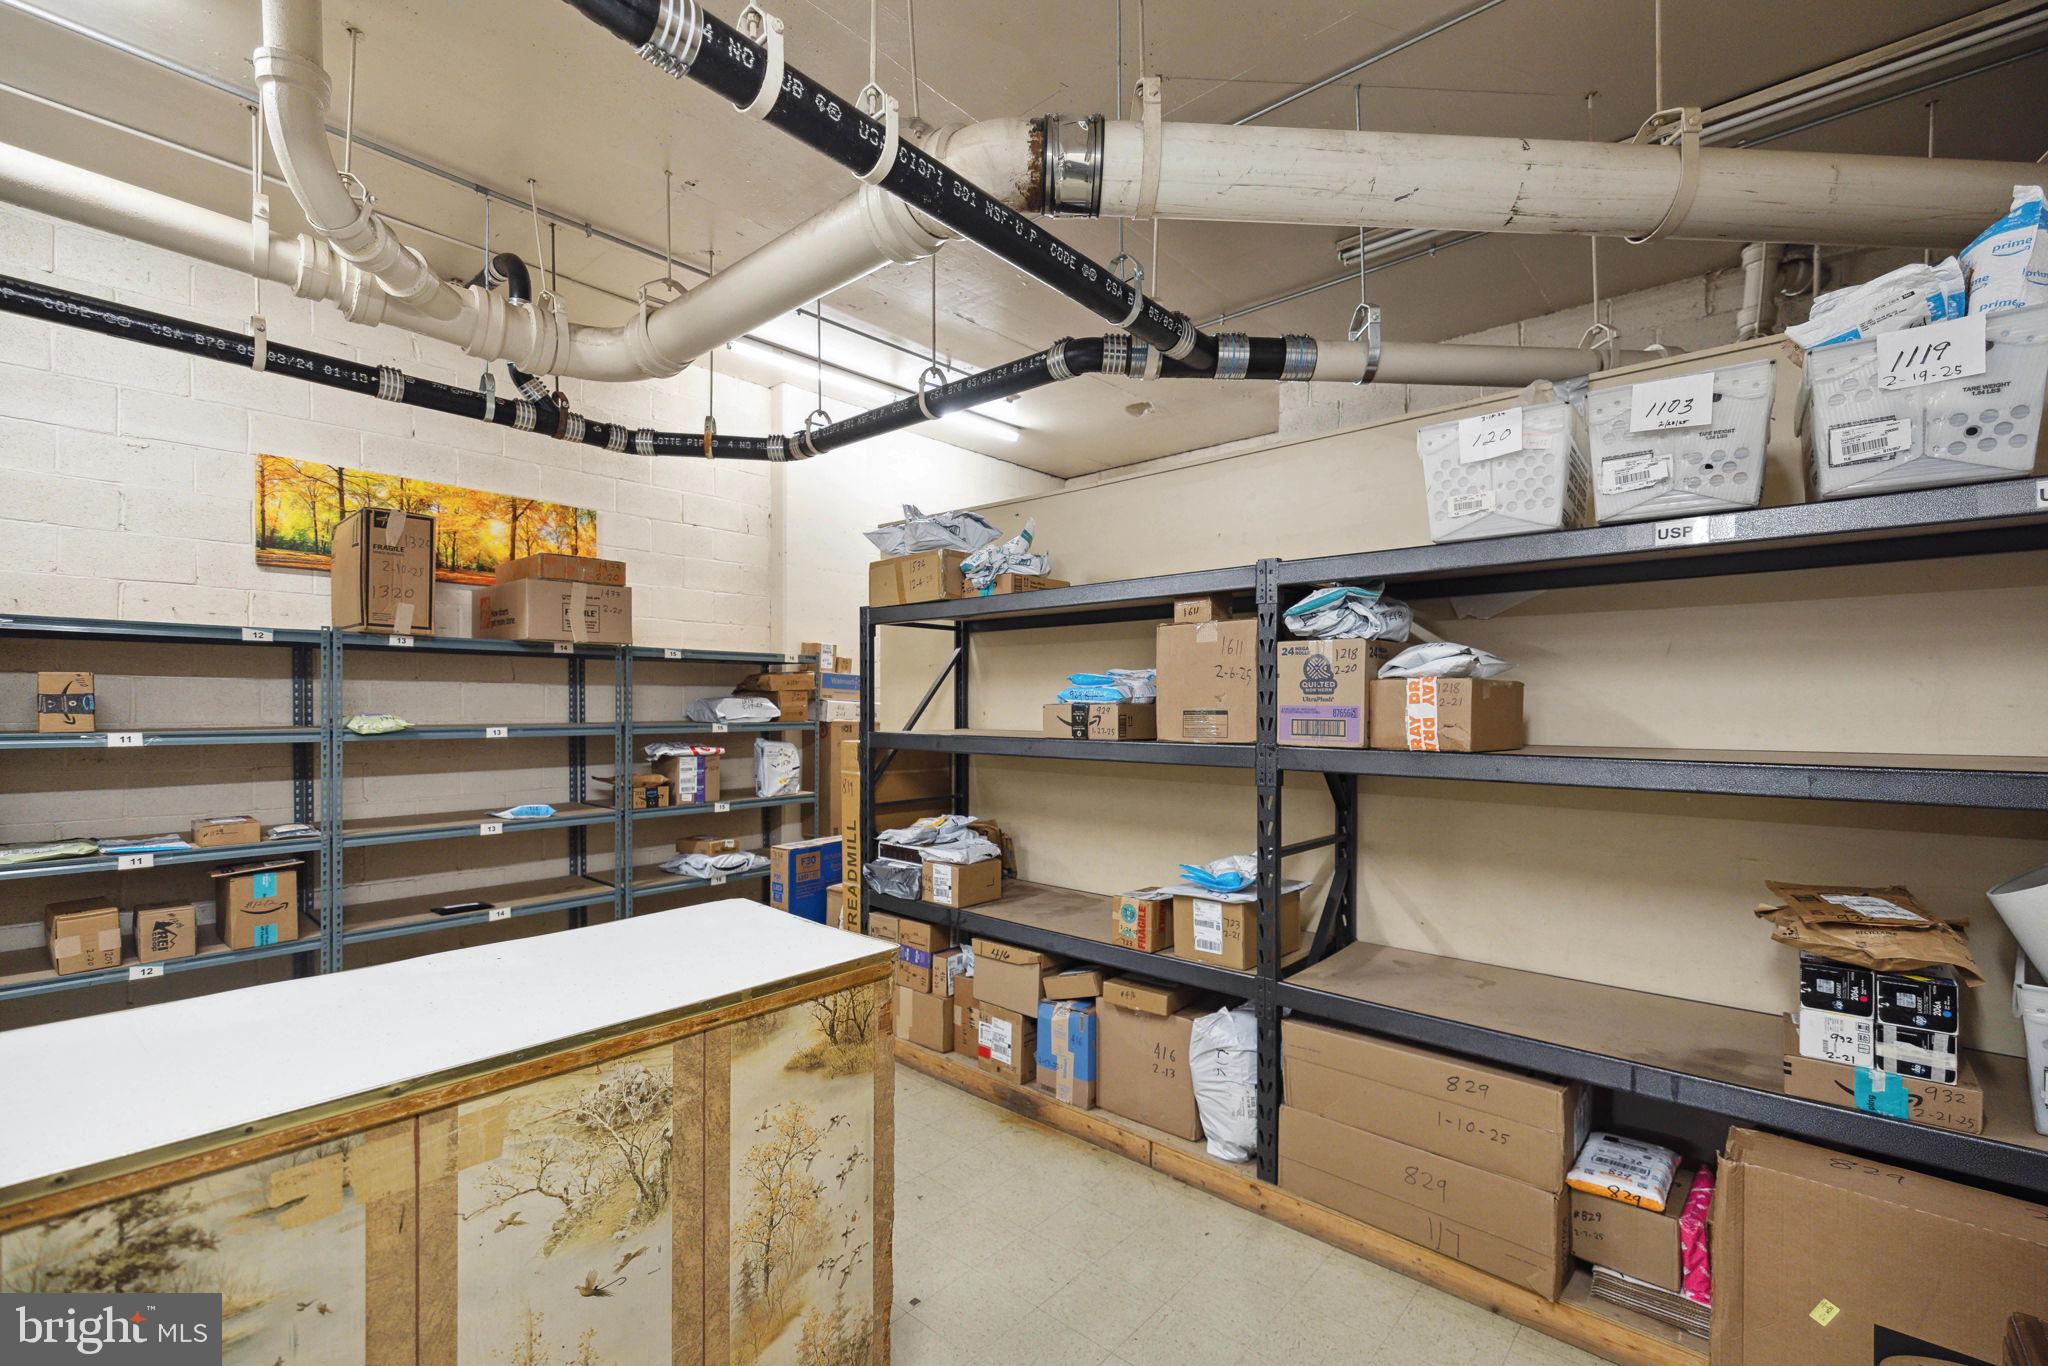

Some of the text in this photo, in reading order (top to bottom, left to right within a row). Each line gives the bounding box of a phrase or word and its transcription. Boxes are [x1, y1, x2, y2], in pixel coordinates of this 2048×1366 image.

[1992, 236, 2033, 254] prime
[1050, 242, 1077, 271] CODE
[1106, 278, 1123, 299] CSA
[1149, 305, 1184, 337] 05/03/2
[236, 343, 315, 372] 0503/24
[1890, 341, 1952, 373] 1119
[1882, 364, 1963, 387] 2-19-25
[1962, 381, 2012, 393] TARE WEIGHT
[1645, 397, 1695, 418] 1103
[1472, 428, 1512, 448] 120
[1657, 526, 1693, 540] USP
[373, 544, 405, 553] FRAGILE
[371, 585, 415, 599] 1320
[252, 631, 265, 640] 12
[396, 637, 407, 645] 13
[1281, 647, 1295, 656] 24
[1335, 648, 1358, 661] 1218
[119, 736, 132, 744] 11
[130, 857, 143, 866] 11
[1137, 902, 1147, 950] FRAGILE
[1224, 917, 1240, 930] 723
[140, 968, 154, 976] 12
[1851, 986, 1859, 1001] 206A
[1932, 1001, 1942, 1016] 206A
[1830, 1033, 1853, 1044] 932
[1154, 1042, 1176, 1062] 416
[1825, 1052, 1855, 1064] 2-21
[1152, 1063, 1176, 1079] 2-13
[1446, 1076, 1489, 1099] 829
[1924, 1086, 1966, 1105] 932
[1437, 1111, 1511, 1146] 1-10-25
[1828, 1157, 1906, 1186] 829
[1404, 1165, 1447, 1203] 829
[1607, 1184, 1642, 1207] 829
